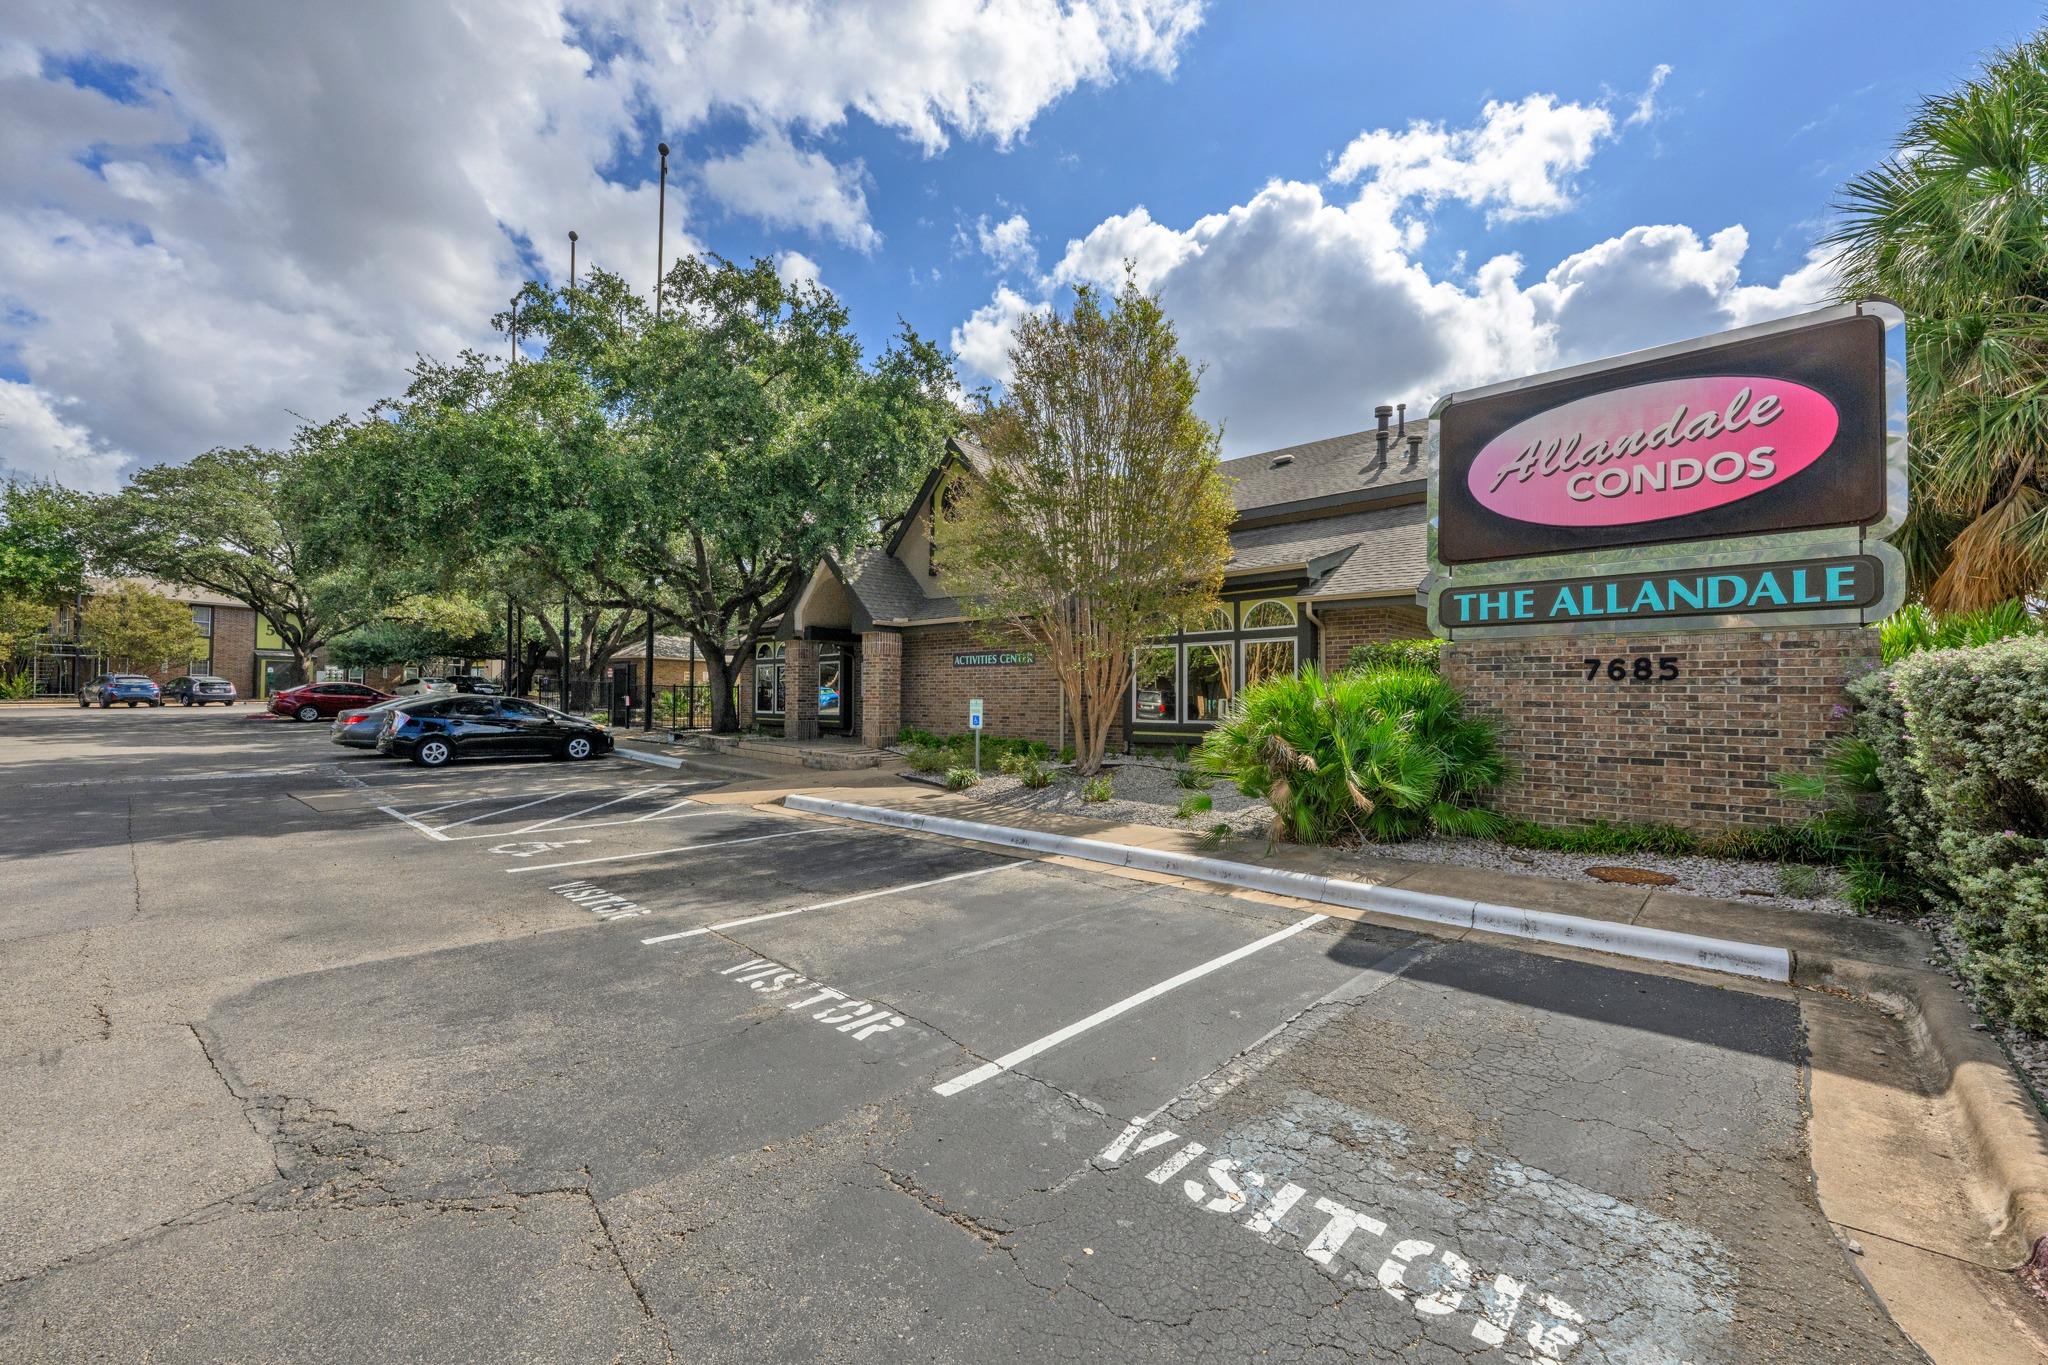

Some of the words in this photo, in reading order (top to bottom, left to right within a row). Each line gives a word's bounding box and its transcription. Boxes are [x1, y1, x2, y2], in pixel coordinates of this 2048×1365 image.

[1490, 387, 1784, 493] Allandale
[1566, 446, 1777, 501] CONDOS
[1454, 589, 1534, 622] THE
[1549, 566, 1856, 616] ALLANDALE
[954, 654, 997, 665] ACTIVITIES
[1000, 652, 1034, 664] CENTR
[1584, 656, 1680, 682] 7685
